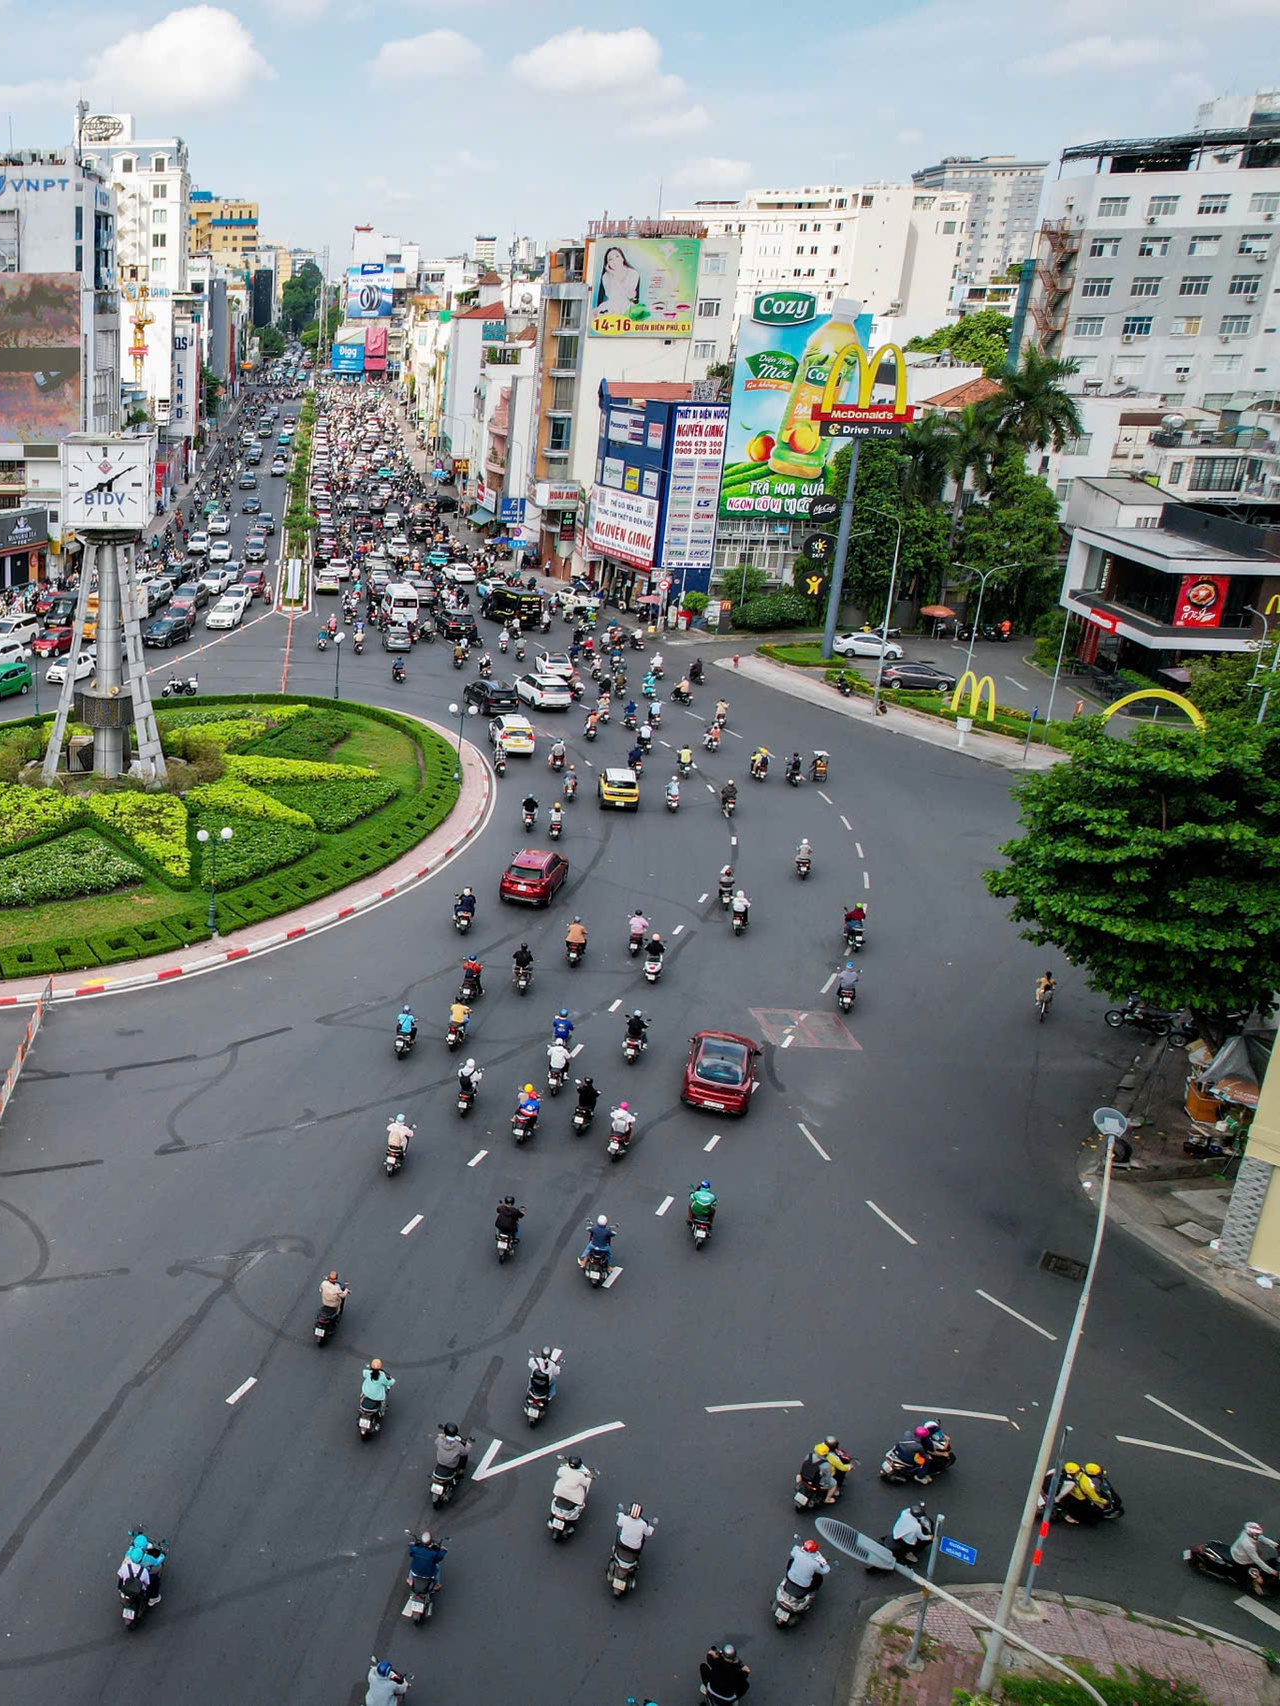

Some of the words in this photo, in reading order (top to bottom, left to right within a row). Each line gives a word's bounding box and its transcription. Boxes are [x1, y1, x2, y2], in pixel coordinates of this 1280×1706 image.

[10, 179, 70, 192] VNPT
[759, 298, 810, 318] Cozy
[594, 319, 631, 331] 14-16
[757, 364, 791, 379] Mới
[831, 410, 893, 420] McDonald's
[704, 424, 724, 437] GIANG
[843, 425, 869, 434] Drive
[872, 425, 892, 435] Thru
[749, 480, 770, 494] TRÀ
[774, 483, 795, 495] HOA
[801, 478, 824, 495] QUẢ
[85, 492, 125, 505] BIDV
[697, 499, 712, 507] LS
[728, 498, 753, 510] NGON
[771, 499, 781, 511] VỊ
[628, 531, 651, 550] GIANG
